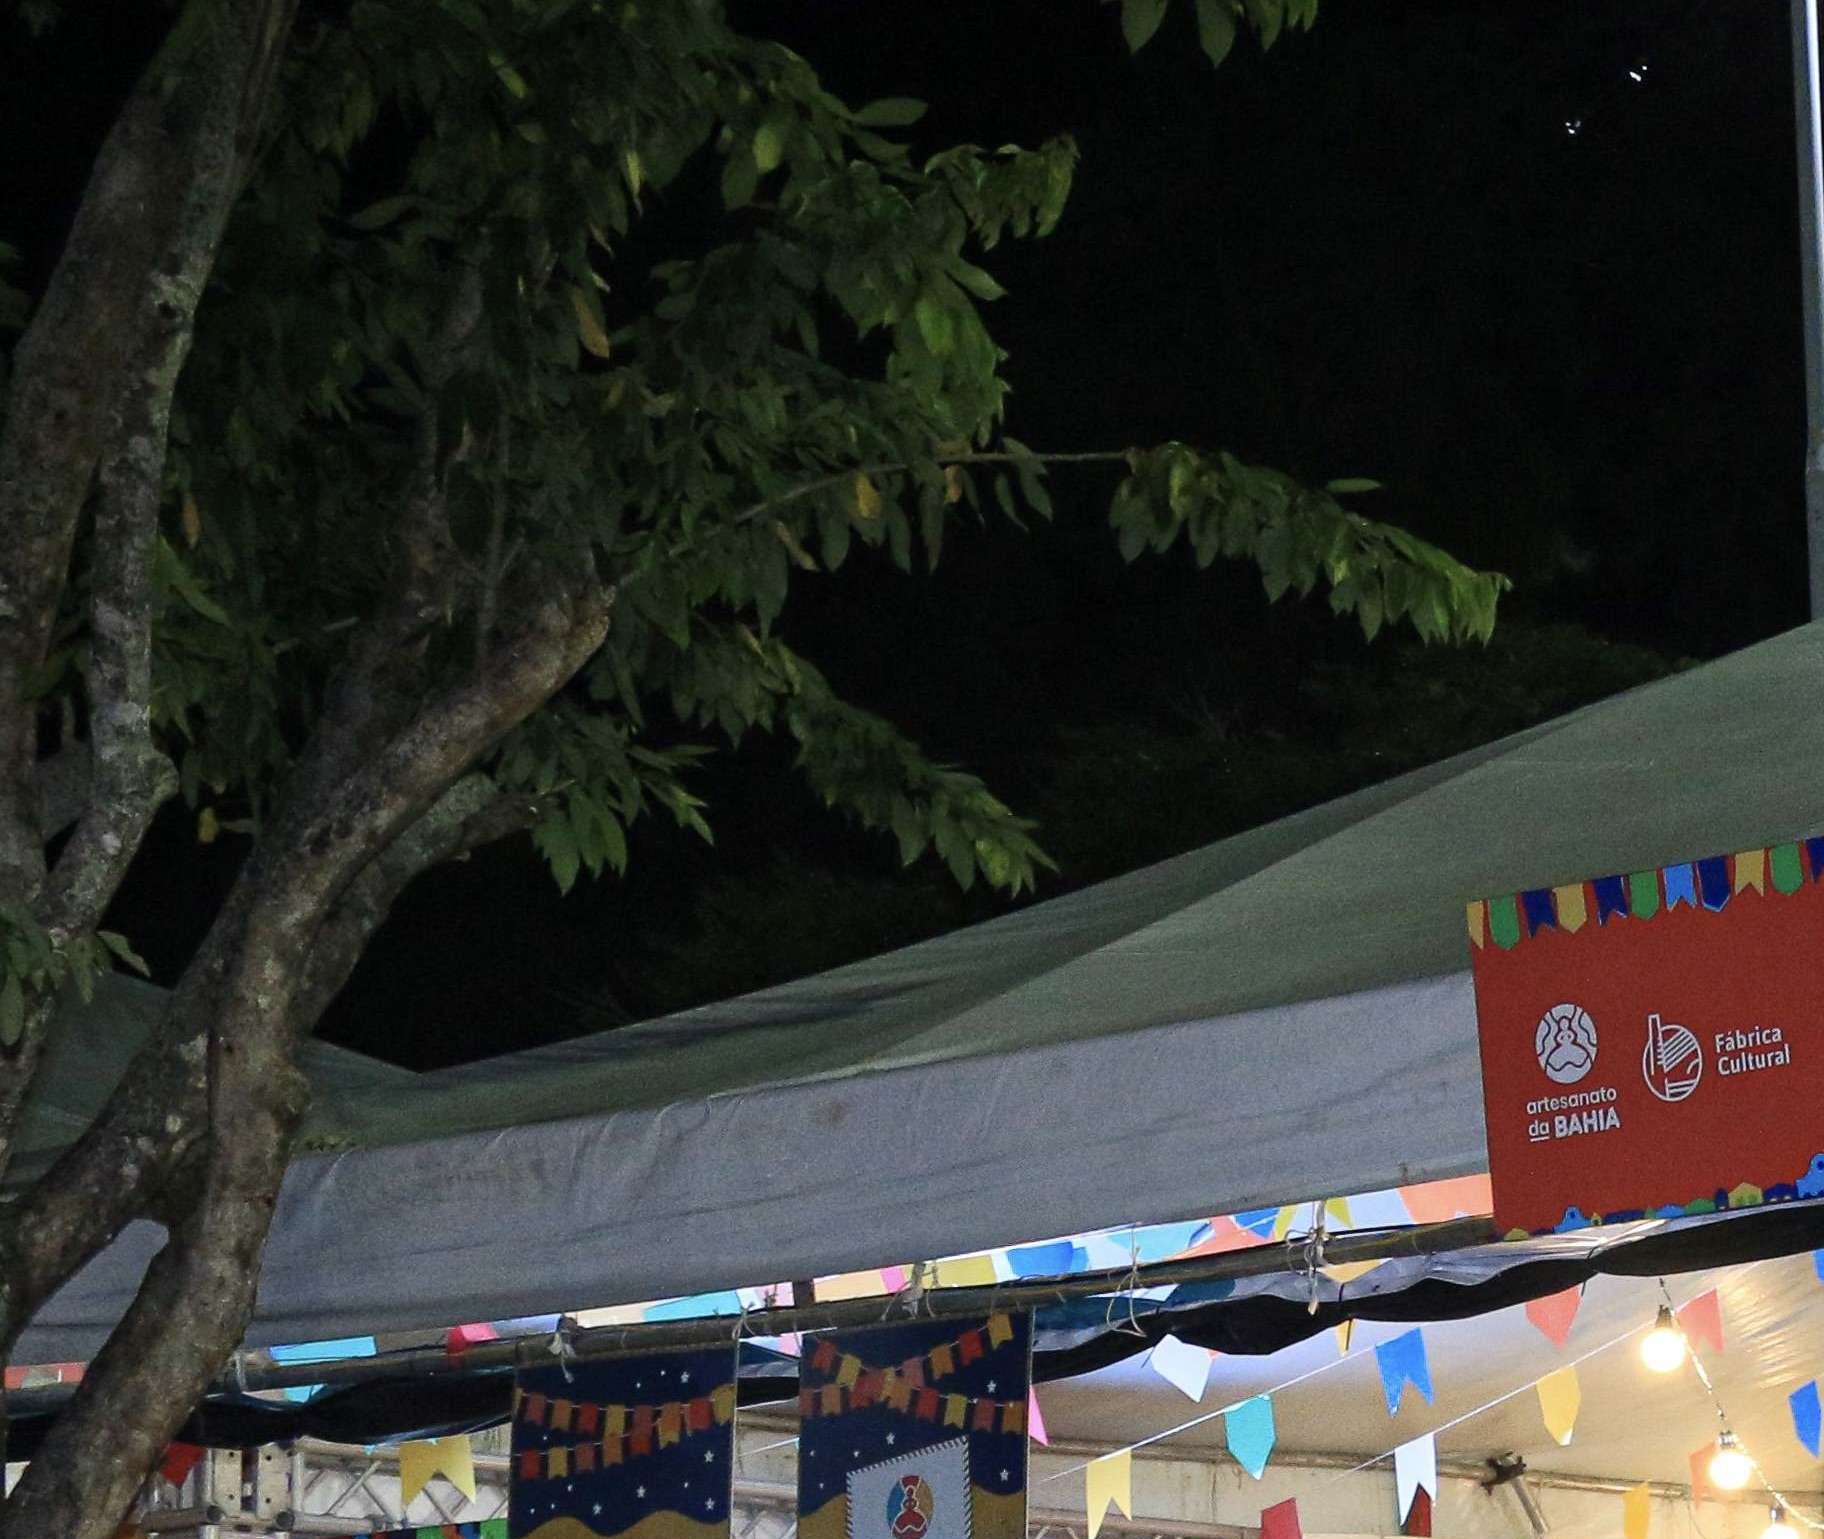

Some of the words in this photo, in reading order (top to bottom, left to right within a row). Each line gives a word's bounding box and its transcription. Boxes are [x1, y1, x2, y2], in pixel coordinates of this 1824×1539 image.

[1715, 1026, 1782, 1053] Fábrica
[1717, 1044, 1790, 1075] Cultural
[1526, 1086, 1617, 1115] artesanato
[1528, 1120, 1550, 1139] da
[1554, 1106, 1621, 1138] BAHIA
